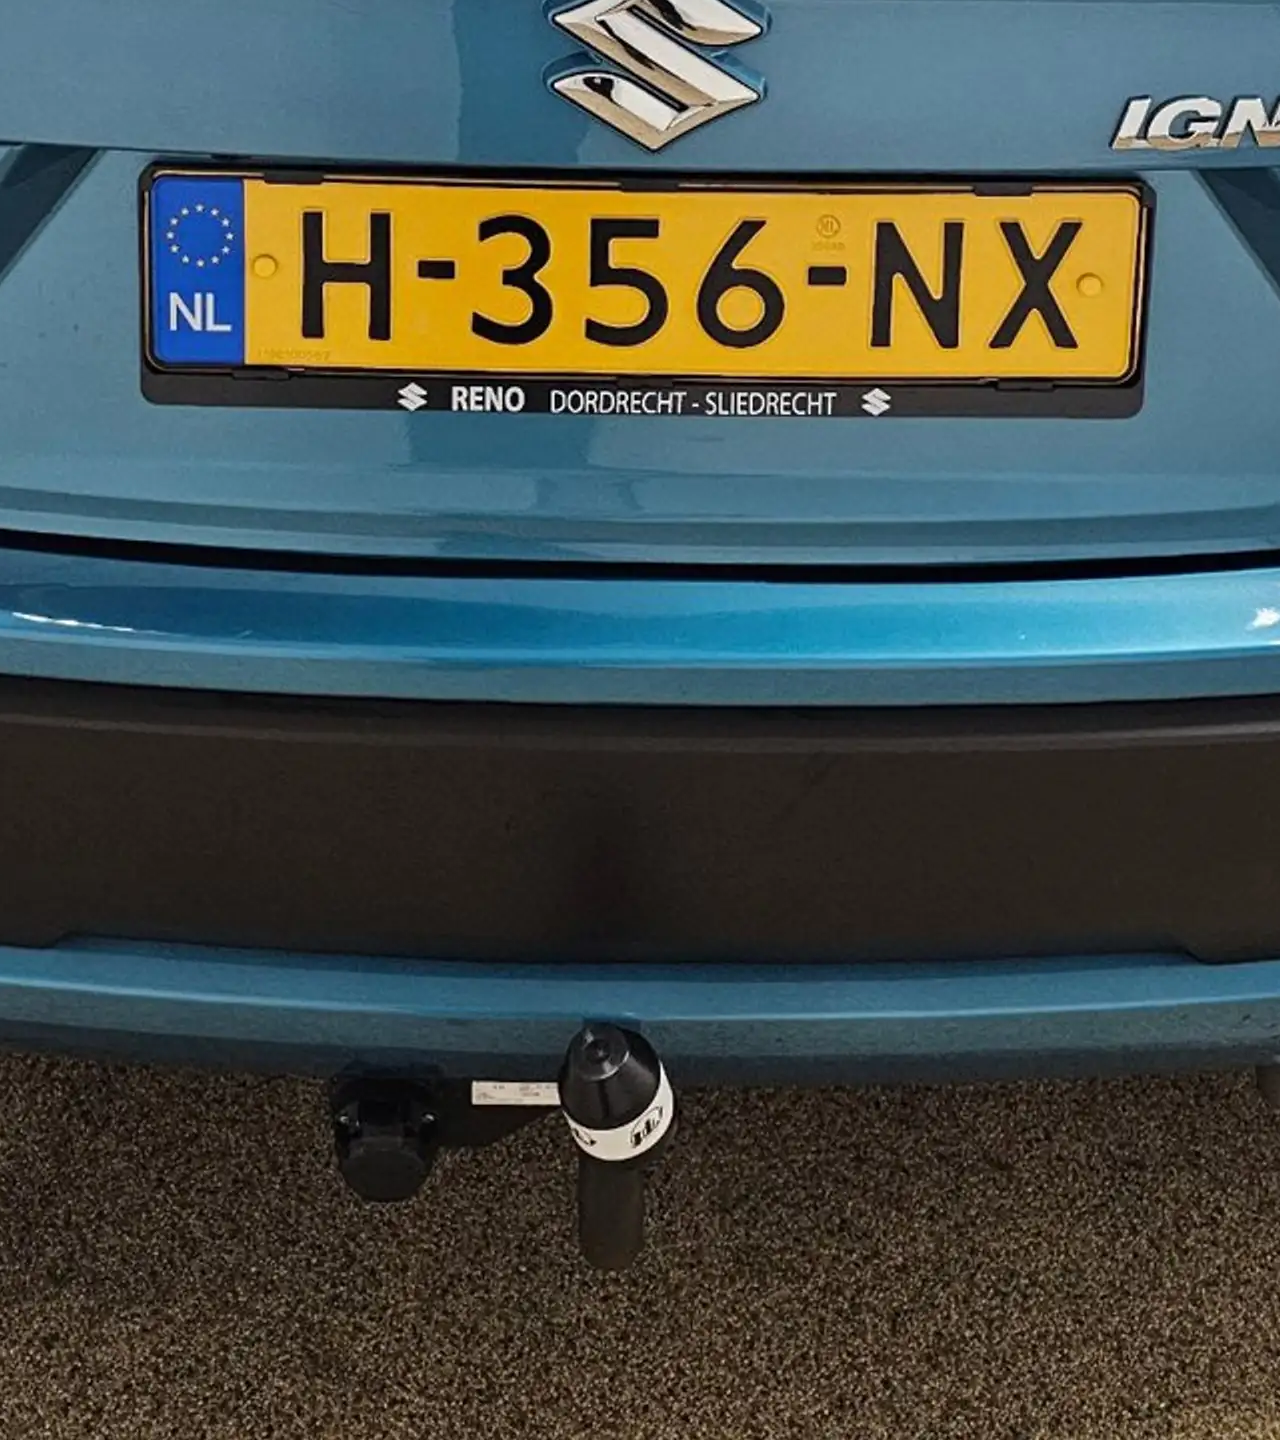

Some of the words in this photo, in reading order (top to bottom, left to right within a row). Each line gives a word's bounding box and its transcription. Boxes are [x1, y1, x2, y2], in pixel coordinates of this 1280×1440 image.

[301, 211, 1083, 349] H-356-NX
[169, 292, 232, 332] NL
[451, 386, 525, 412] RENO
[550, 389, 688, 414] DORDRECHT
[704, 391, 838, 416] SLIEDRECHT
